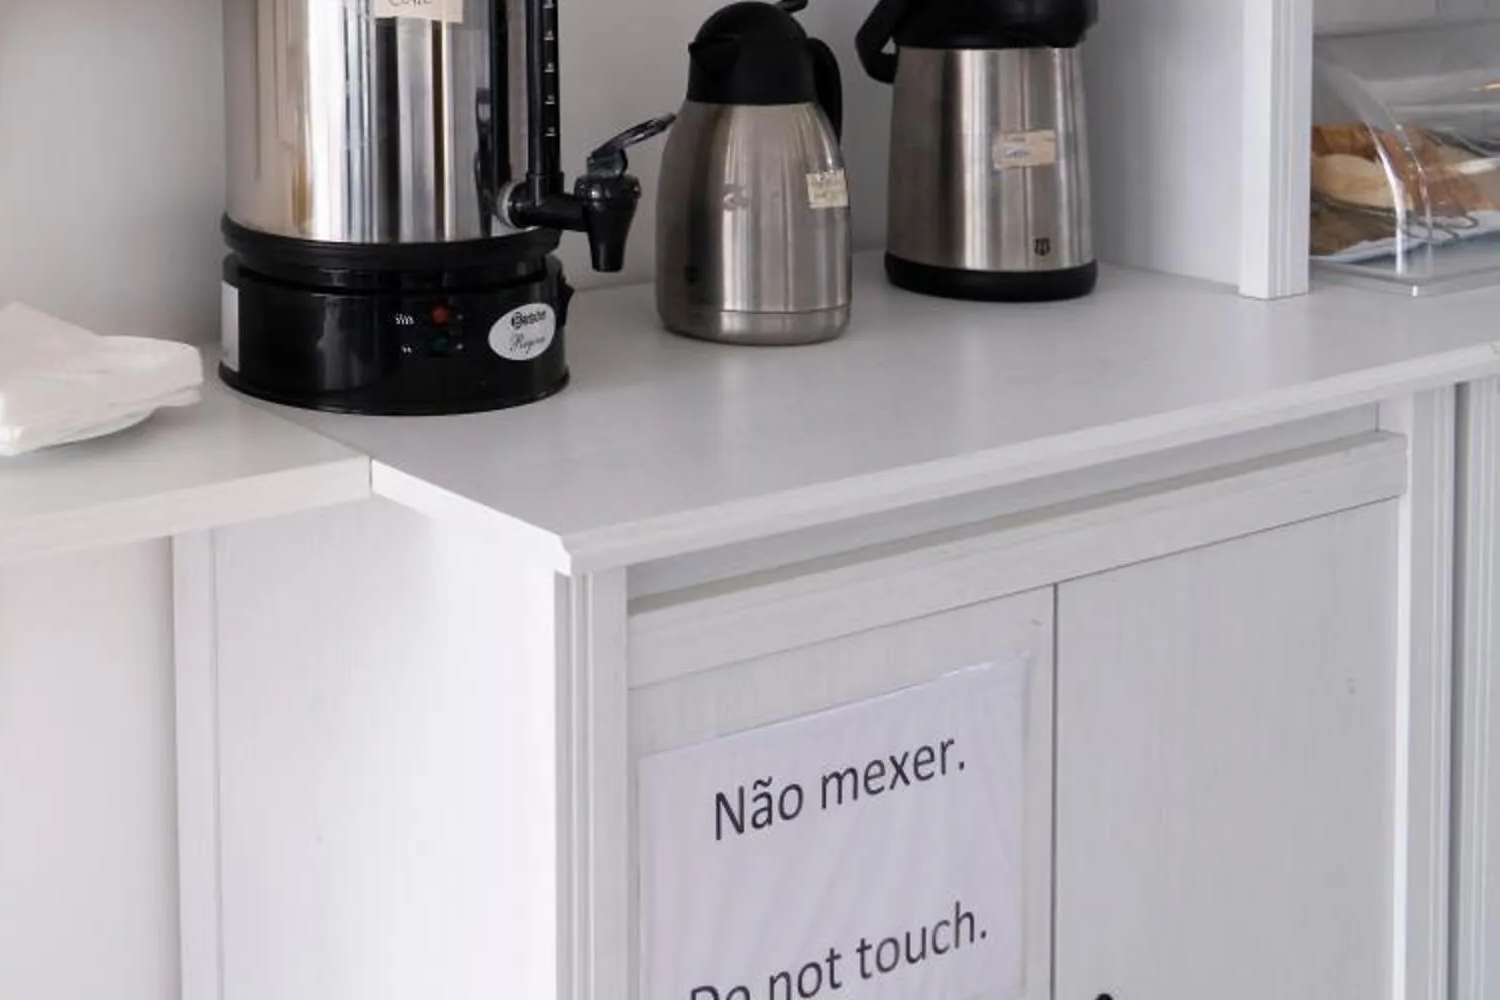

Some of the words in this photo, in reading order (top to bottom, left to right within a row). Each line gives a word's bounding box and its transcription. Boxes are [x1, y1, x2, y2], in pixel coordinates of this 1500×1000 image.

[713, 775, 804, 841] Não
[820, 737, 966, 810] mexer.
[768, 947, 843, 1000] not
[855, 900, 988, 981] touch.
